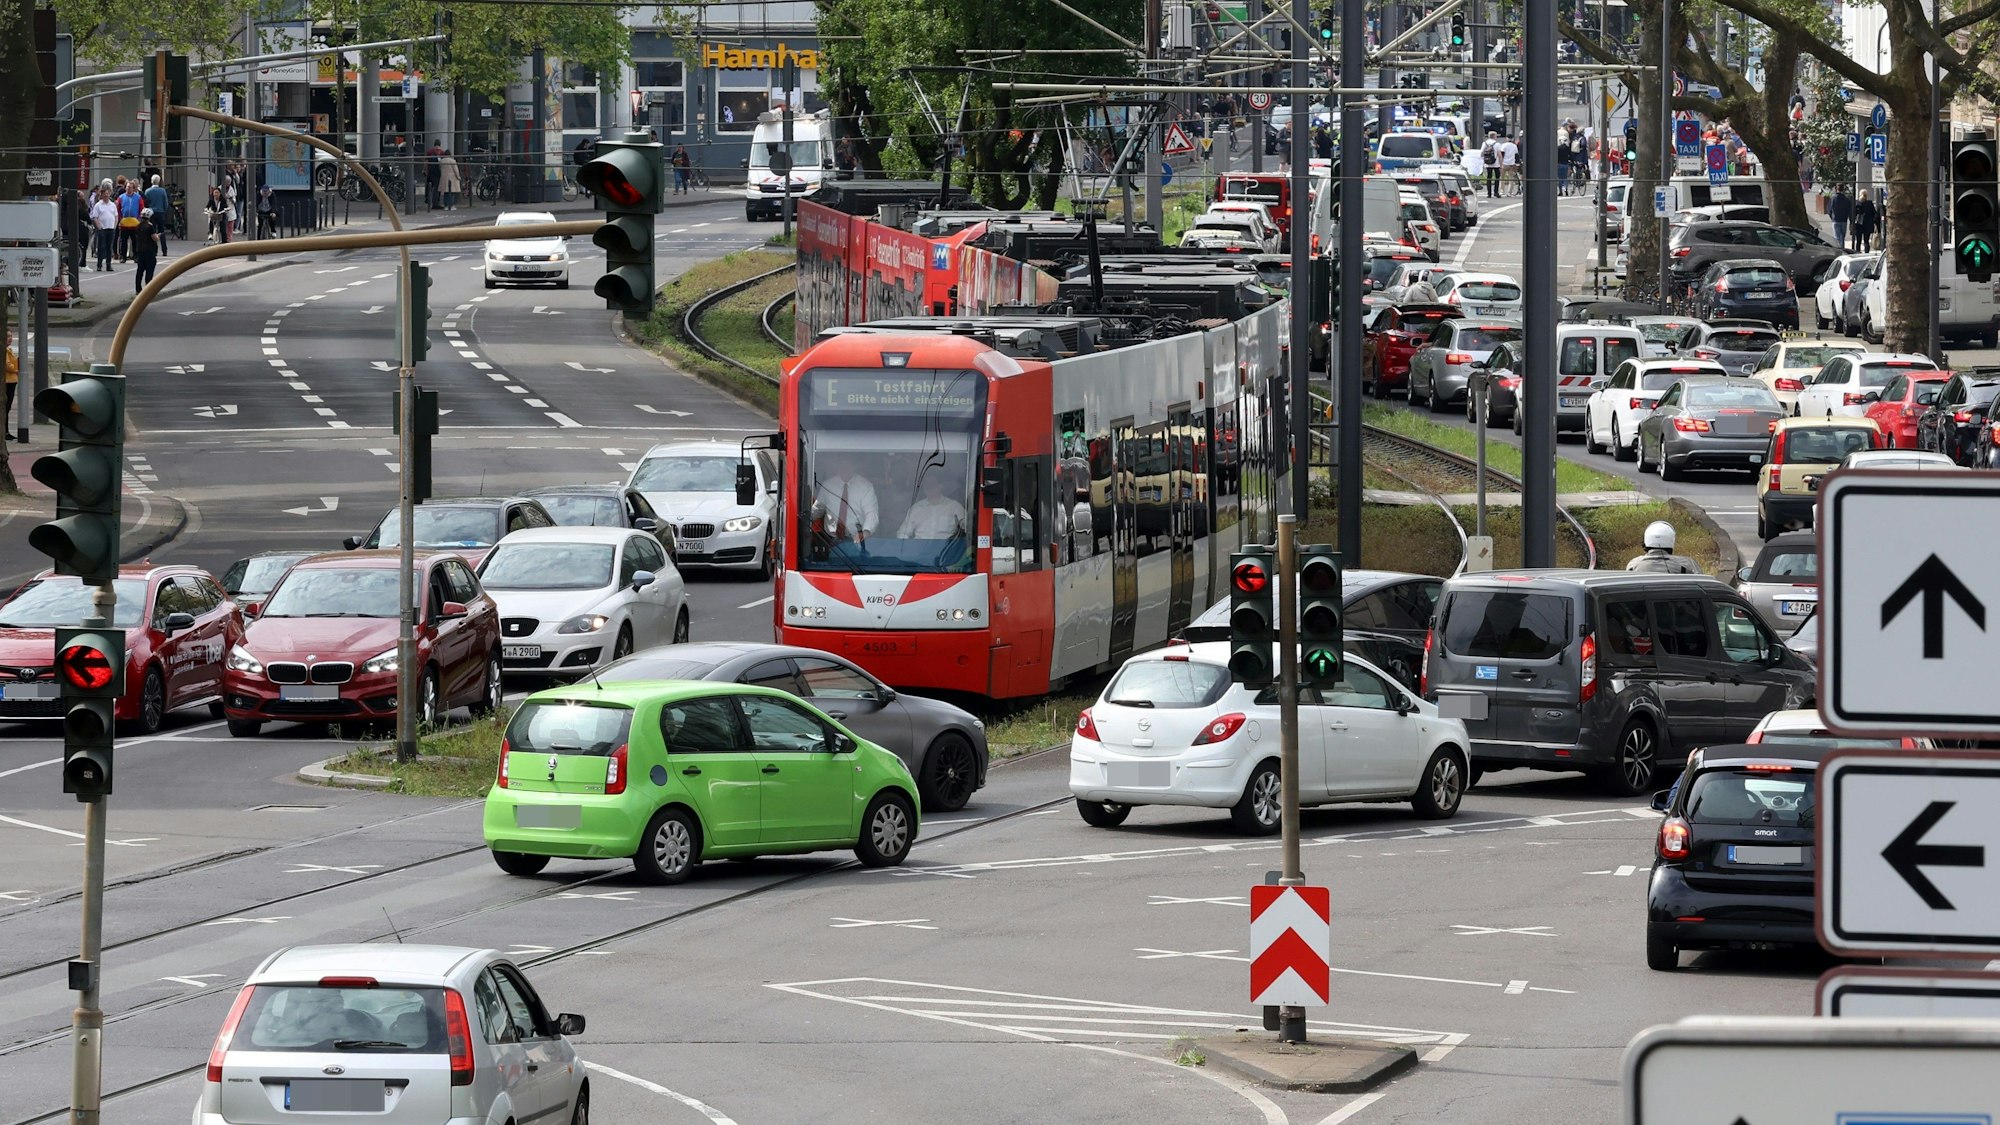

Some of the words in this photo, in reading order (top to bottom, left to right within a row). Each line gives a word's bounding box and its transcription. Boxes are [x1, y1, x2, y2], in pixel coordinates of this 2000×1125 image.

[270, 66, 306, 75] MoneyGram
[1253, 94, 1266, 103] 30
[1678, 144, 1698, 154] TAXI
[1710, 172, 1728, 181] TAXI
[874, 380, 947, 393] Testfahrt
[827, 379, 838, 406] E
[847, 394, 877, 404] Bitte
[881, 394, 910, 404] nicht
[914, 395, 973, 406] einsteigen
[866, 596, 883, 604] KVB
[863, 642, 897, 652] 4503
[519, 648, 539, 657] 2900
[1754, 829, 1778, 837] smart
